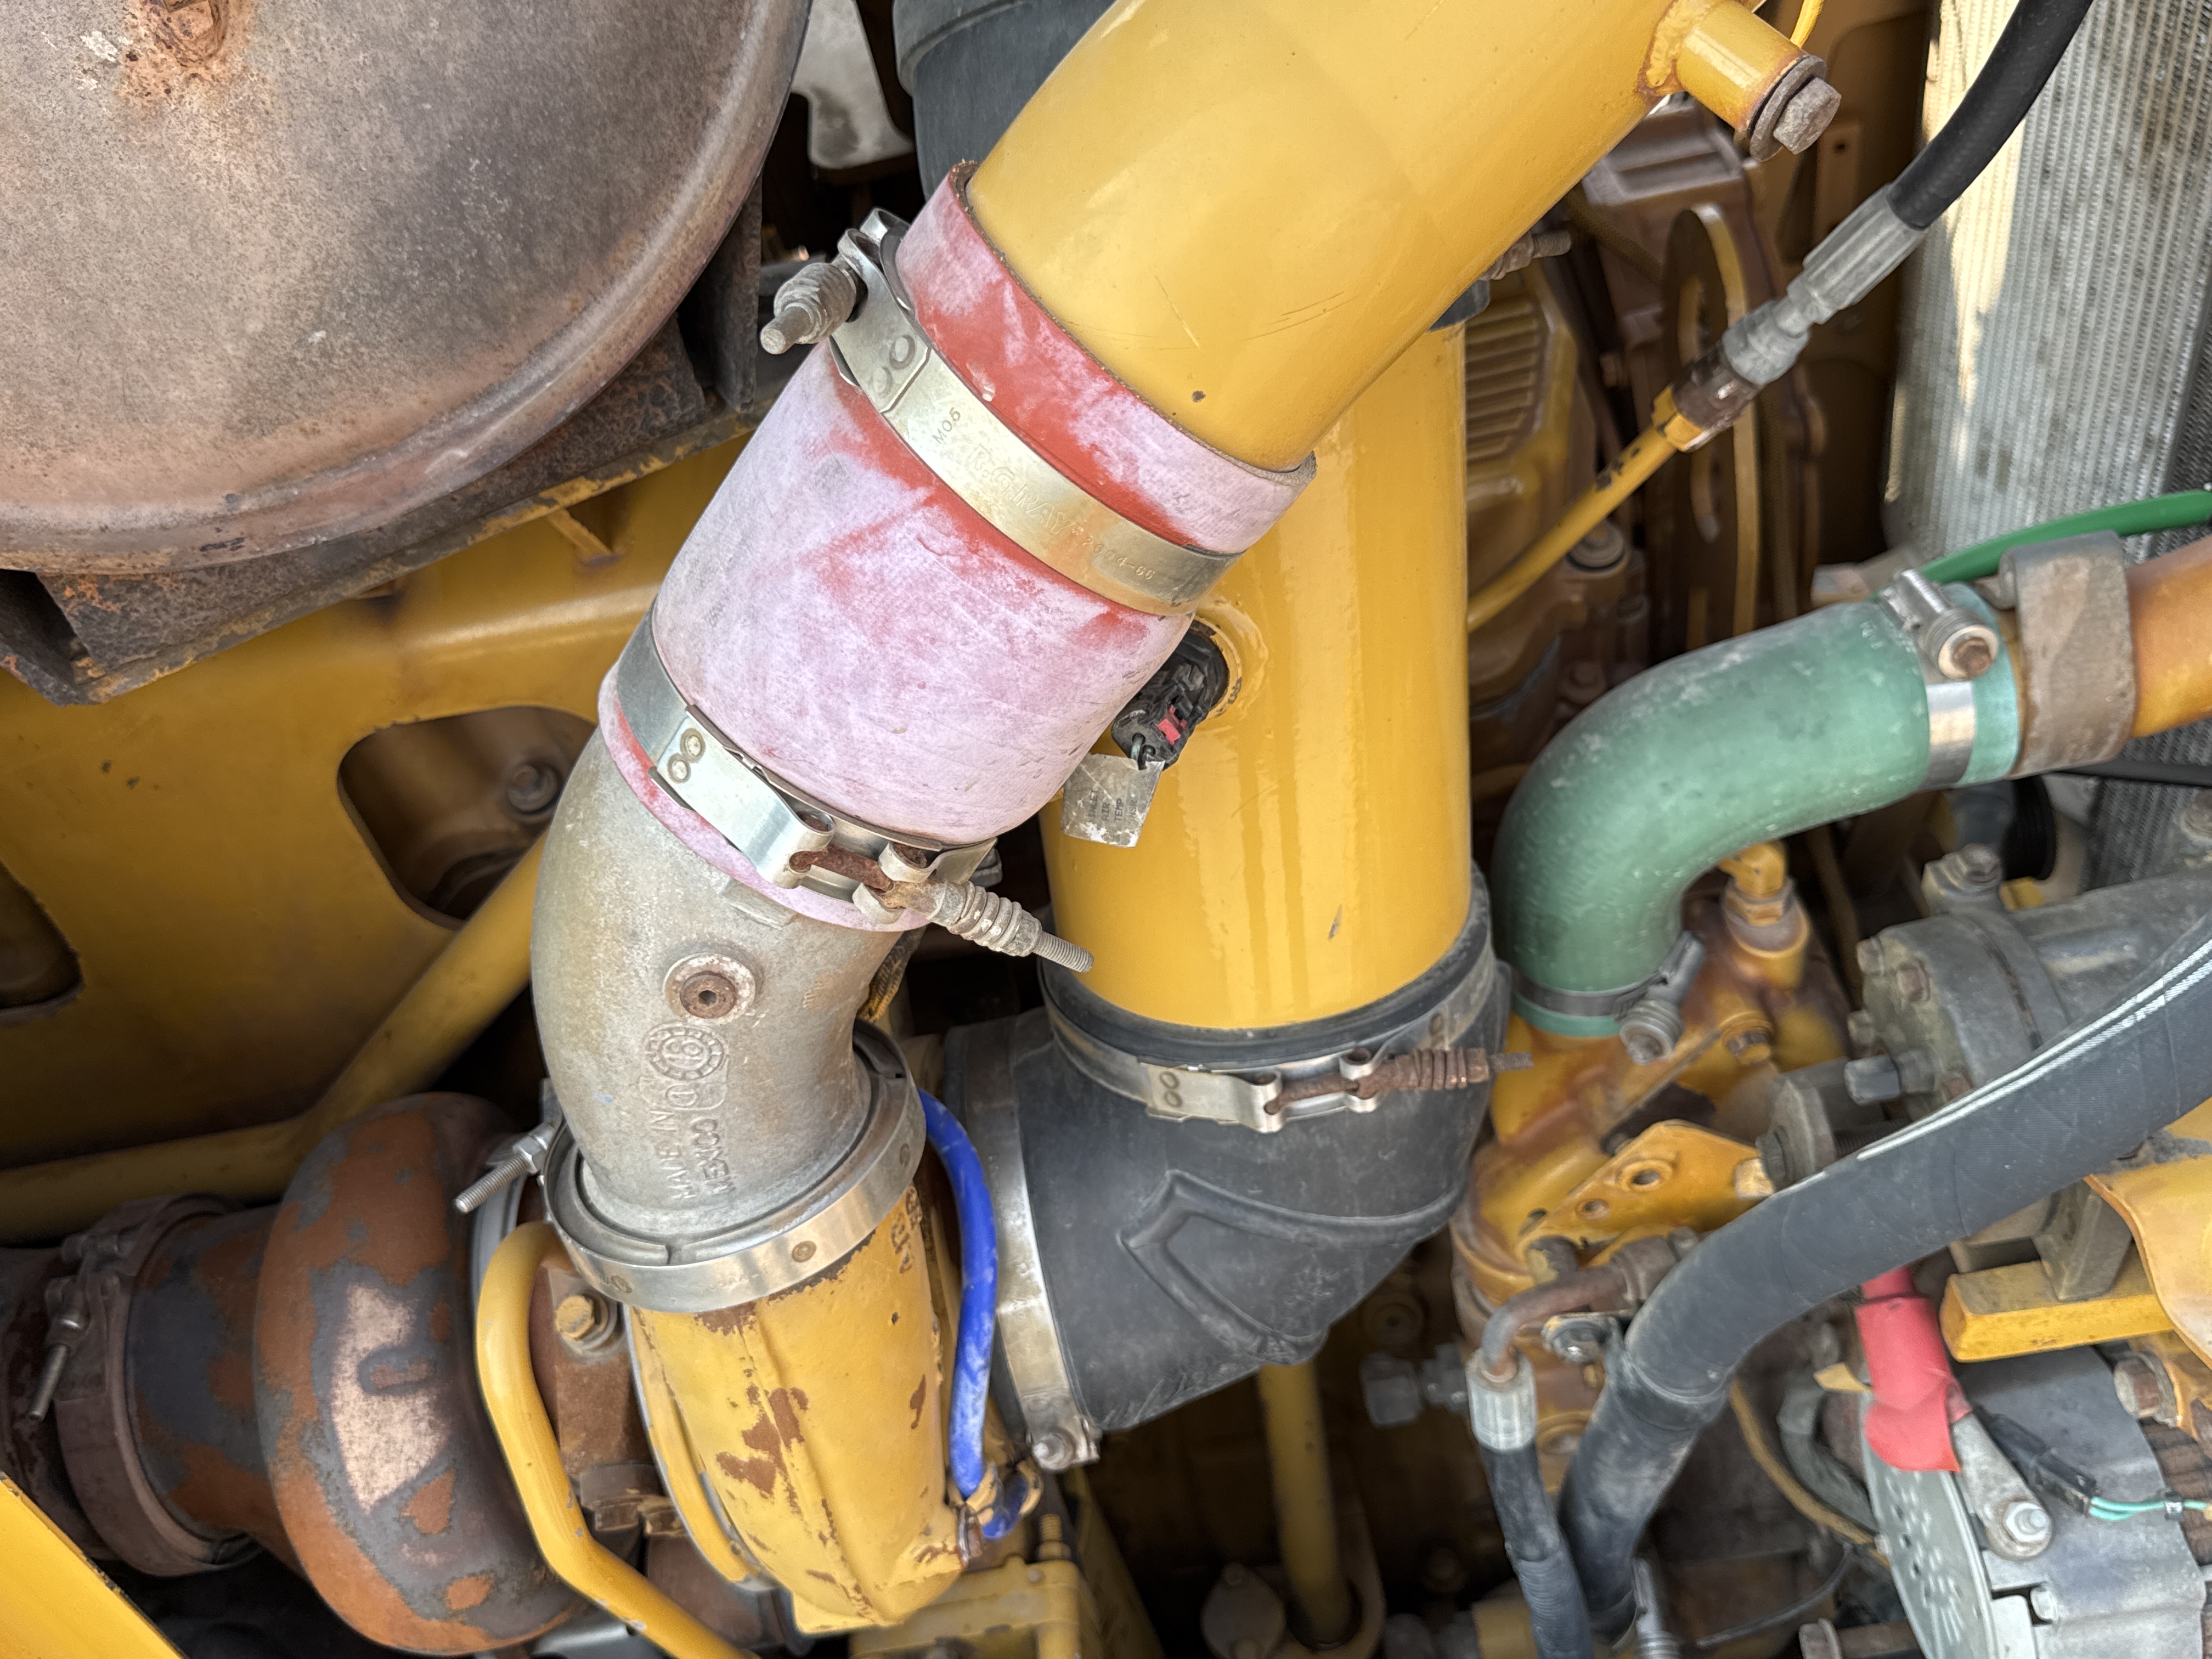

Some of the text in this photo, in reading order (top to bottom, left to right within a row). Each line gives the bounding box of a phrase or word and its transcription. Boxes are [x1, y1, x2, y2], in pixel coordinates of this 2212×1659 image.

[1088, 789, 1098, 818] INLET
[1101, 802, 1110, 821] AIR
[1114, 798, 1124, 821] TEMP
[649, 1109, 698, 1198] MADE IN
[691, 1118, 736, 1195] MEXICO
